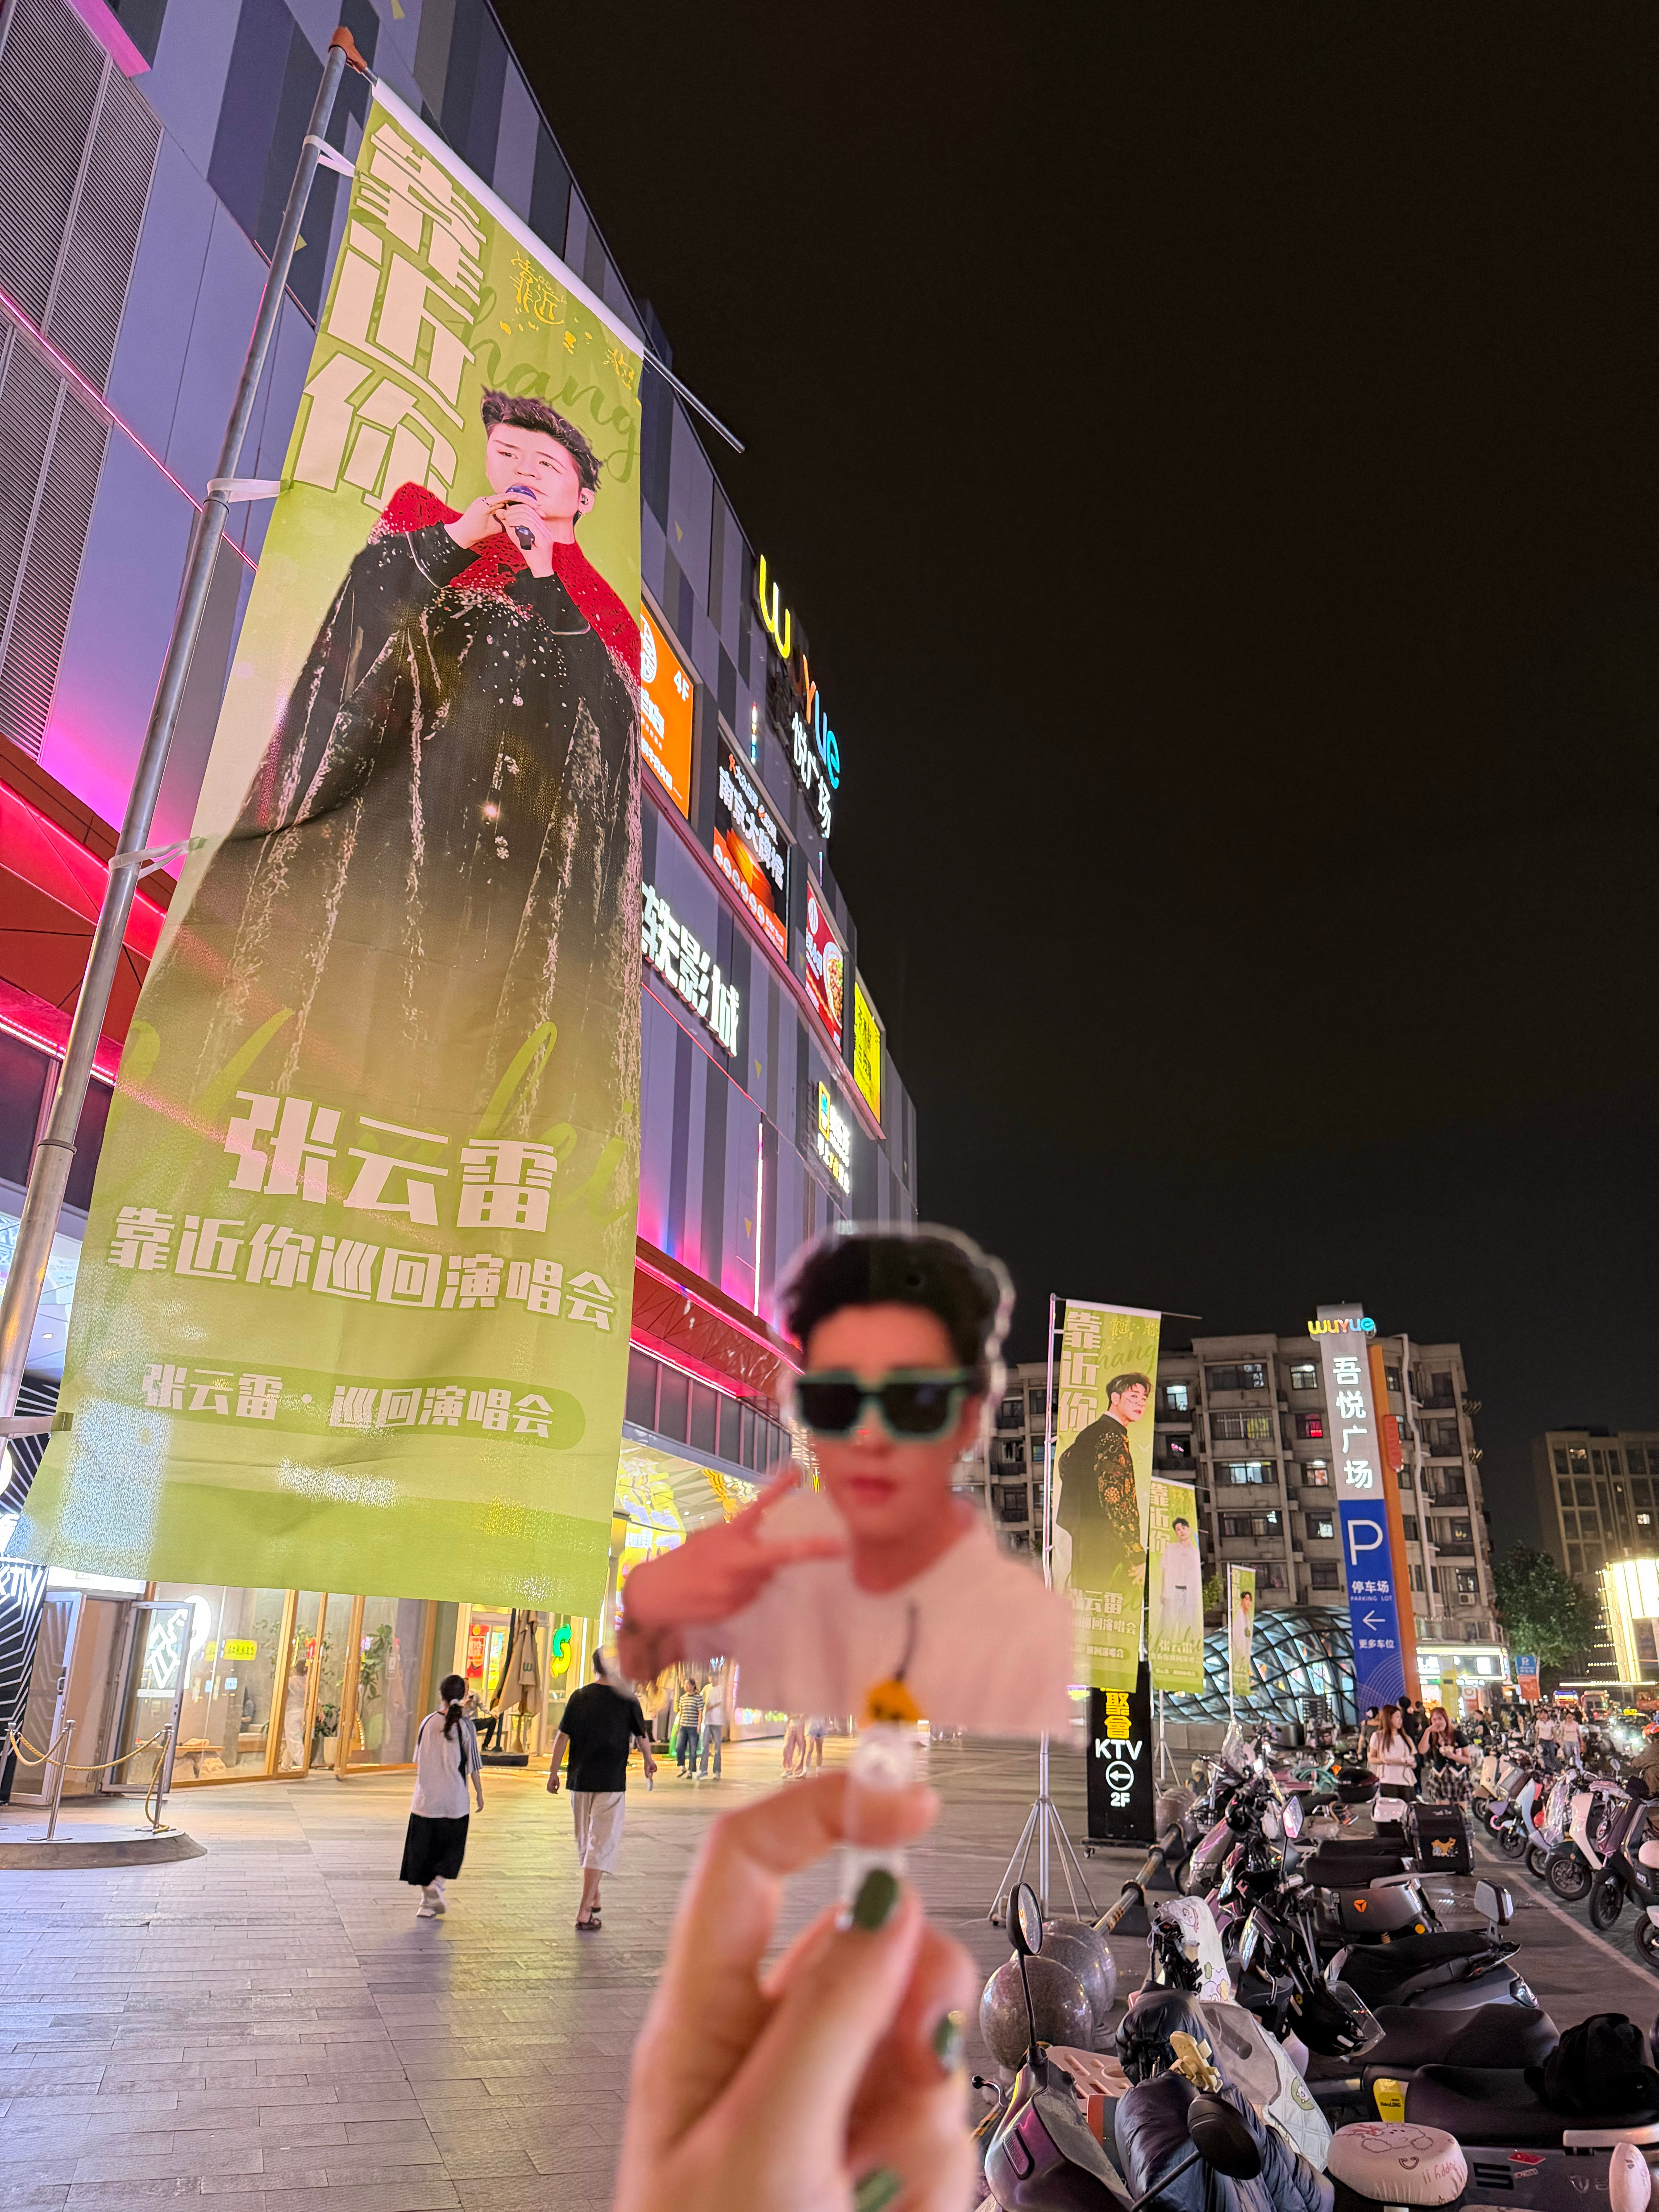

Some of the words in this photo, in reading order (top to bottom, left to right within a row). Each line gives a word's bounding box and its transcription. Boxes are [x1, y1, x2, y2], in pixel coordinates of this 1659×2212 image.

[303, 122, 487, 514] 靠近你
[673, 670, 689, 702] 4F
[642, 881, 739, 1057] 轶影城
[224, 1090, 558, 1233] 张云雷
[108, 1206, 614, 1331] 靠近你巡回演唱会
[1058, 1311, 1102, 1432] 靠近你
[1333, 1356, 1373, 1489] 吾悦广场
[1348, 1520, 1384, 1566] P
[1352, 1580, 1389, 1594] 停车场
[1095, 1738, 1143, 1760] KTV
[1101, 1687, 1132, 1739] 聚會
[1110, 1792, 1130, 1807] 2F
